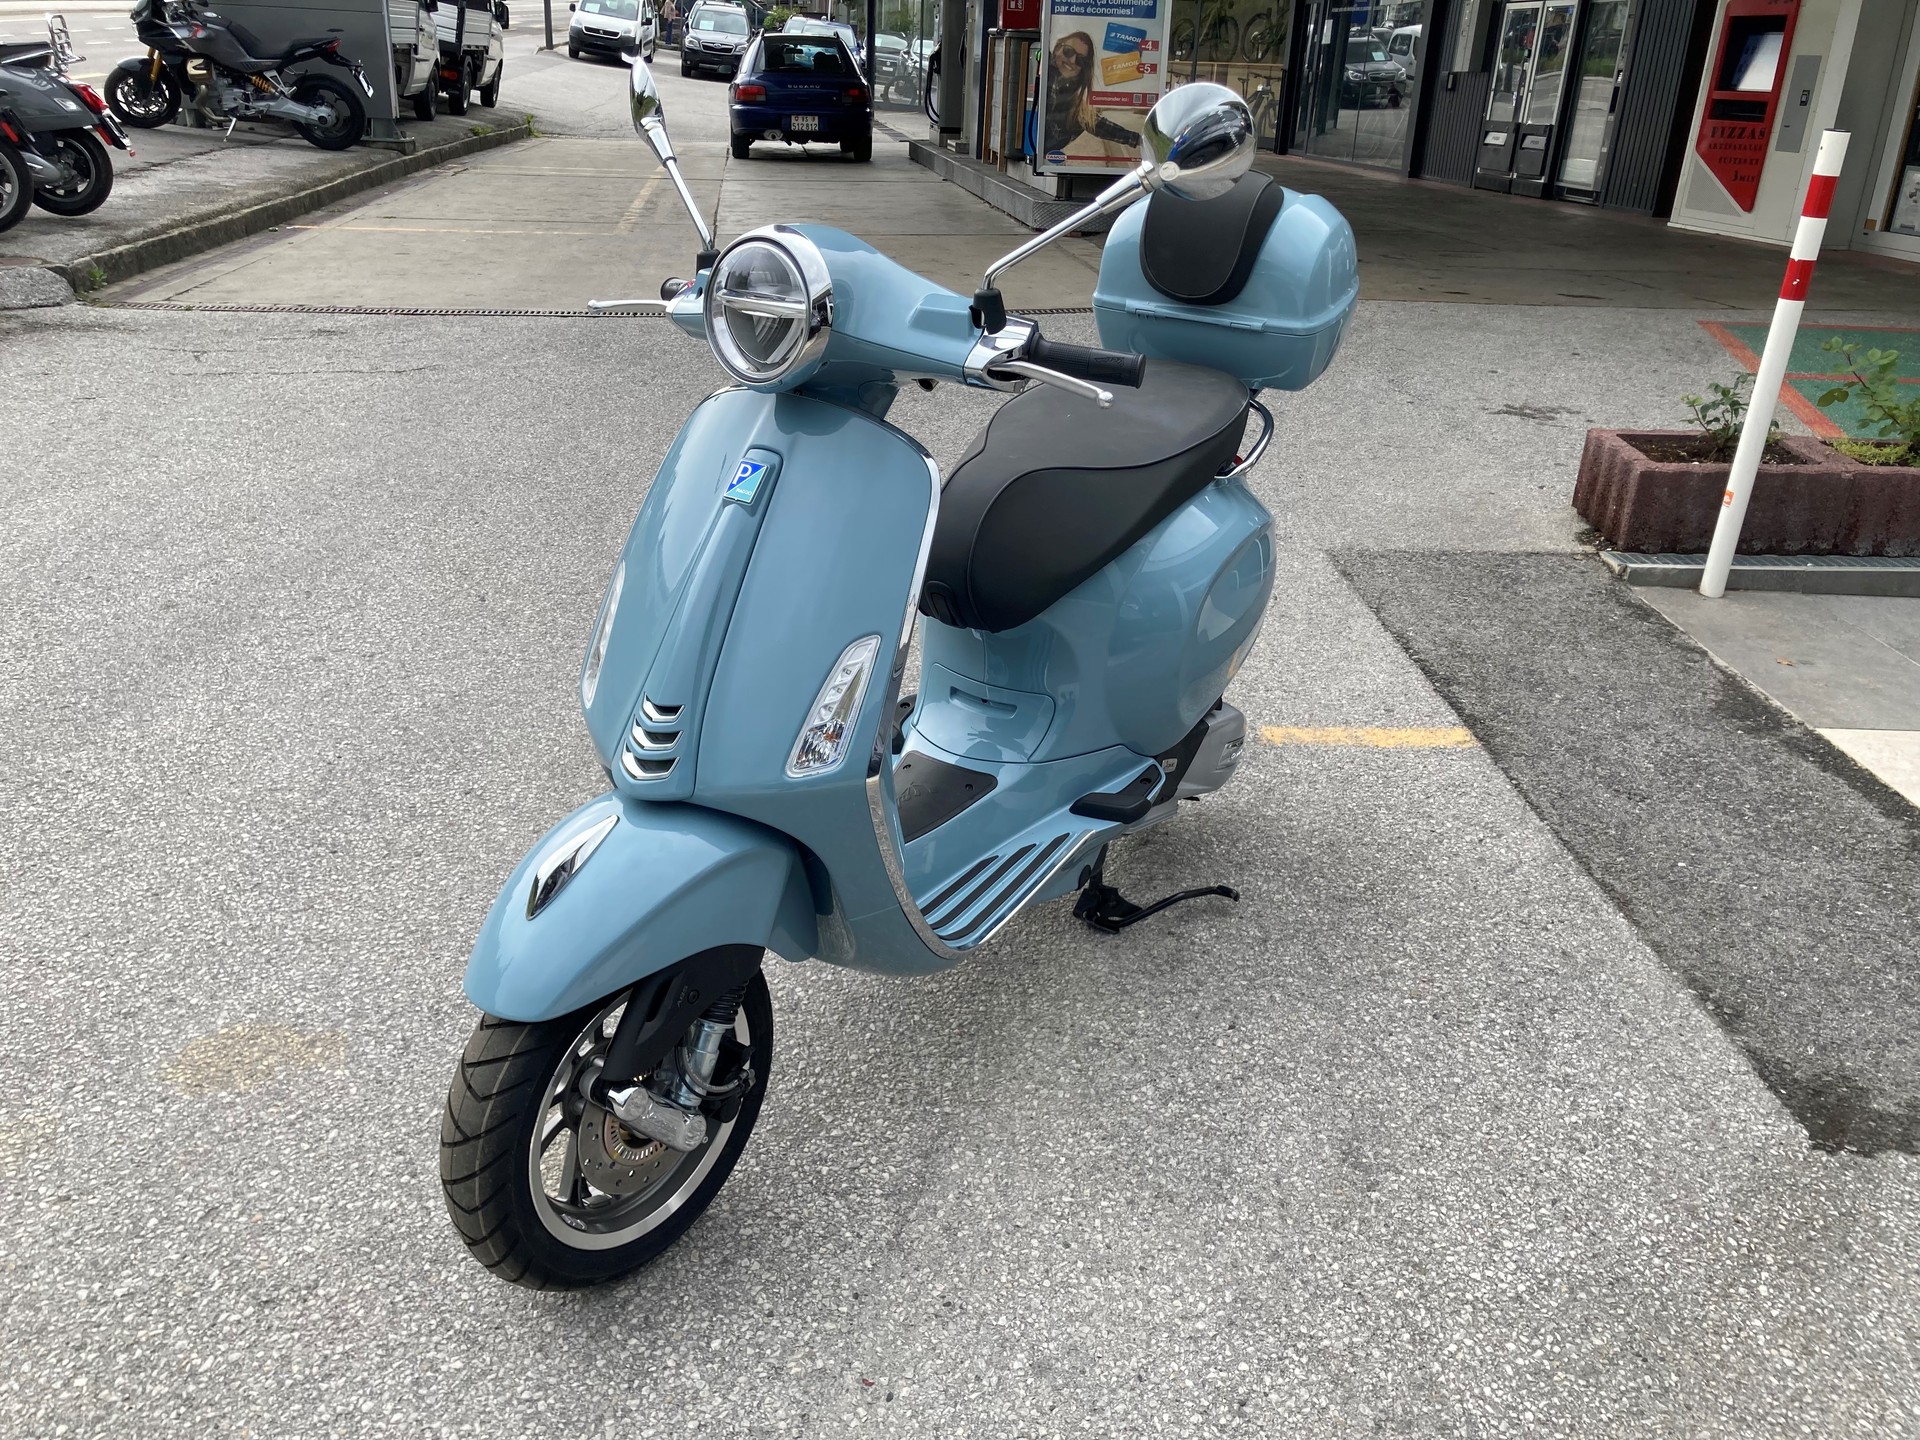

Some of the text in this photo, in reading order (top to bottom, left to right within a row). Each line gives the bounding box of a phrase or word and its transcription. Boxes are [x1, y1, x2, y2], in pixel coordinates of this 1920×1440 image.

[1054, 5, 1133, 15] par des économies!
[1112, 61, 1139, 71] TAMOIL
[1710, 126, 1766, 140] PIZZAS
[732, 463, 753, 485] P
